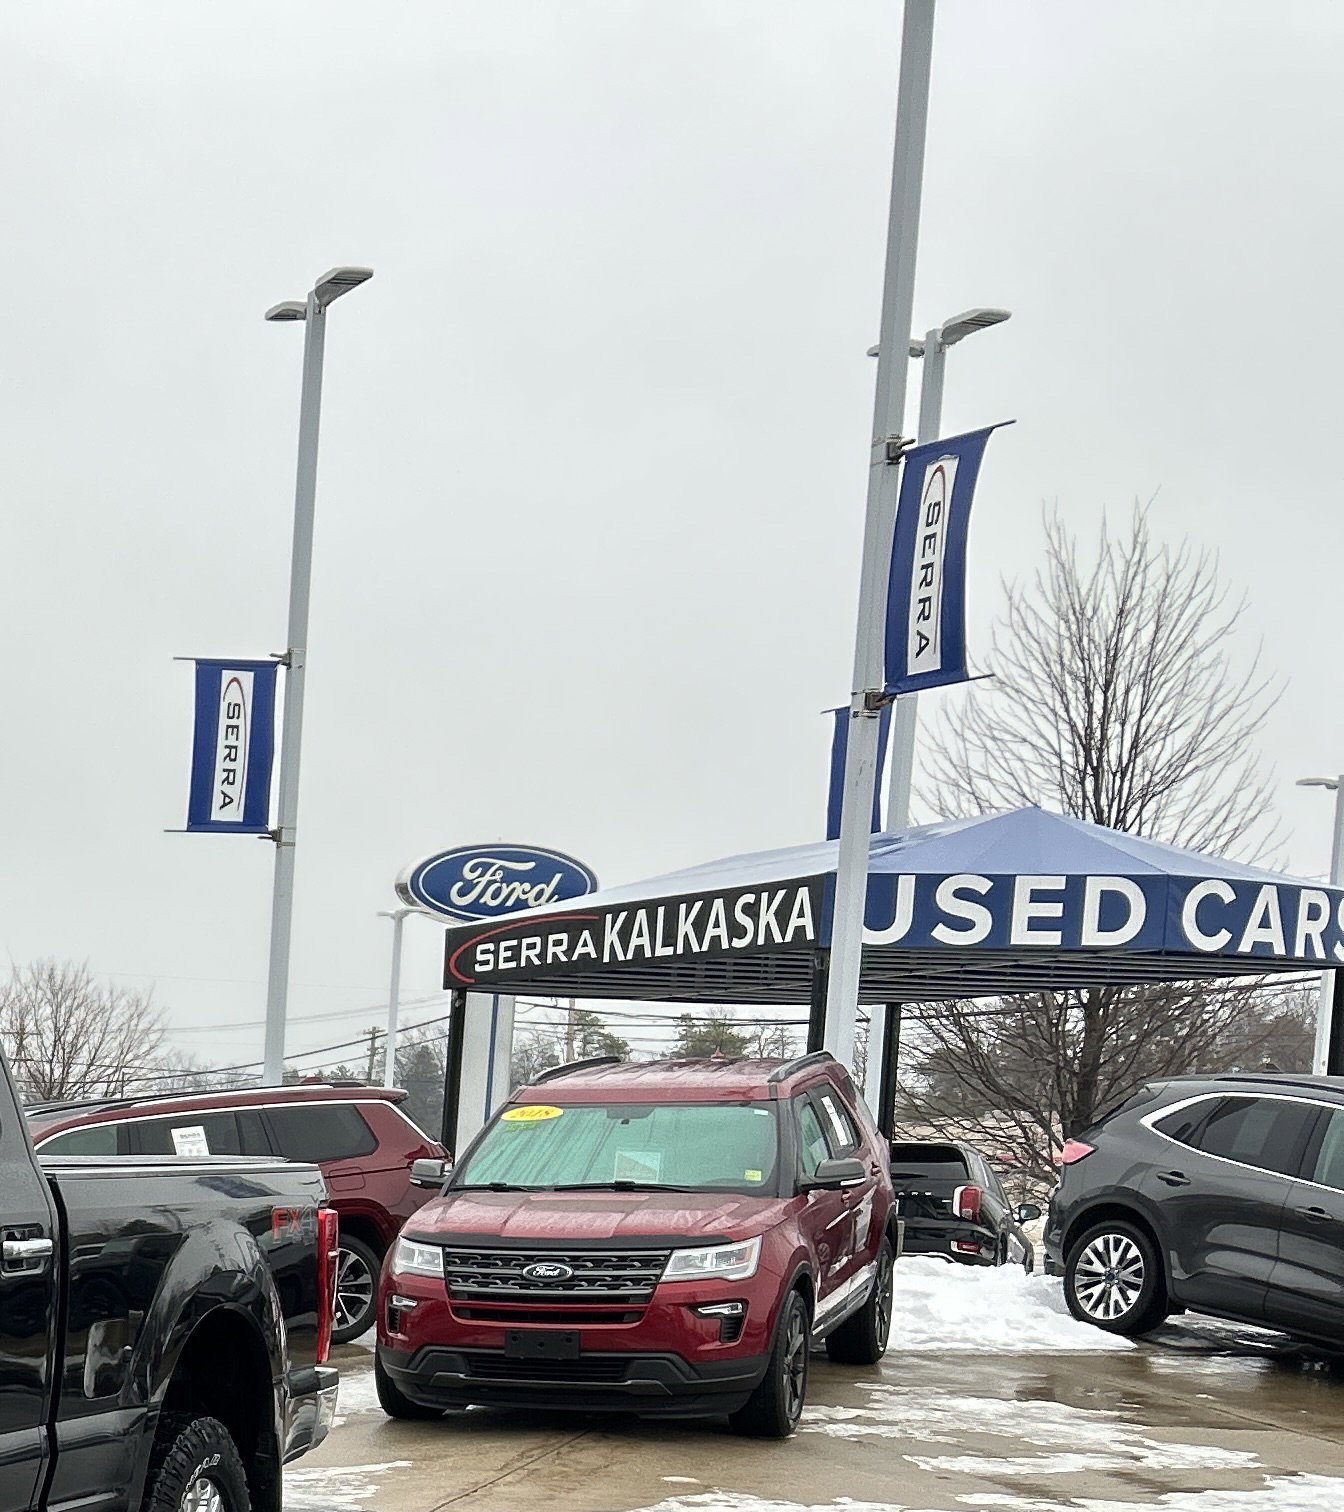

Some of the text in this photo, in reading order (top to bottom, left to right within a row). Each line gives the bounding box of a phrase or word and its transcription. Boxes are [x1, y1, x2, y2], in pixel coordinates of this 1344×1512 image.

[915, 501, 941, 659] SERRA
[219, 701, 241, 811] SERRA
[449, 857, 563, 906] Ford
[862, 873, 1146, 946] USED
[474, 886, 815, 973] SERRA KALKASKA
[272, 1205, 316, 1243] FX4
